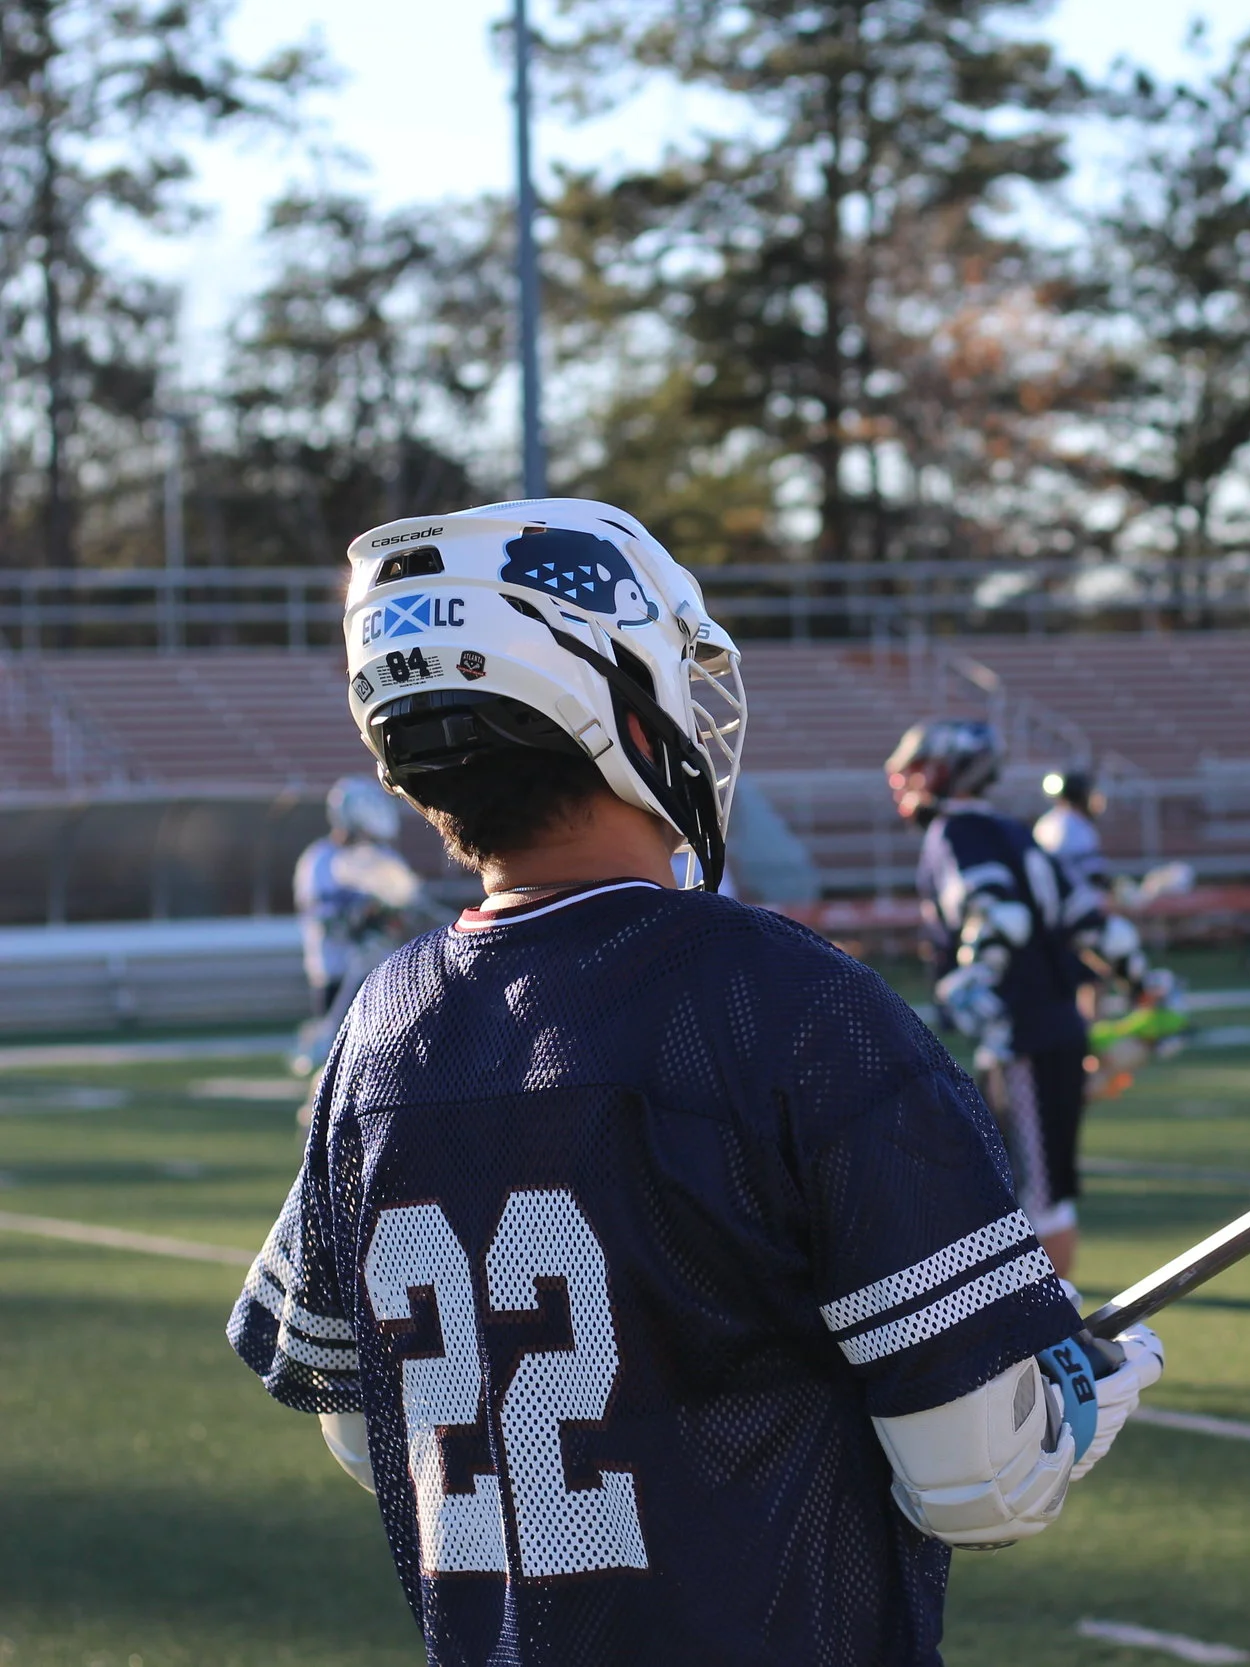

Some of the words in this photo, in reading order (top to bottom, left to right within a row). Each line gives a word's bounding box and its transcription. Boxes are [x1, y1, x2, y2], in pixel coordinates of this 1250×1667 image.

[371, 526, 444, 548] cascade
[362, 610, 382, 646] EC
[434, 598, 465, 627] LC
[386, 646, 431, 683] 84
[463, 652, 483, 665] ATLANTA
[363, 1187, 650, 1578] 22
